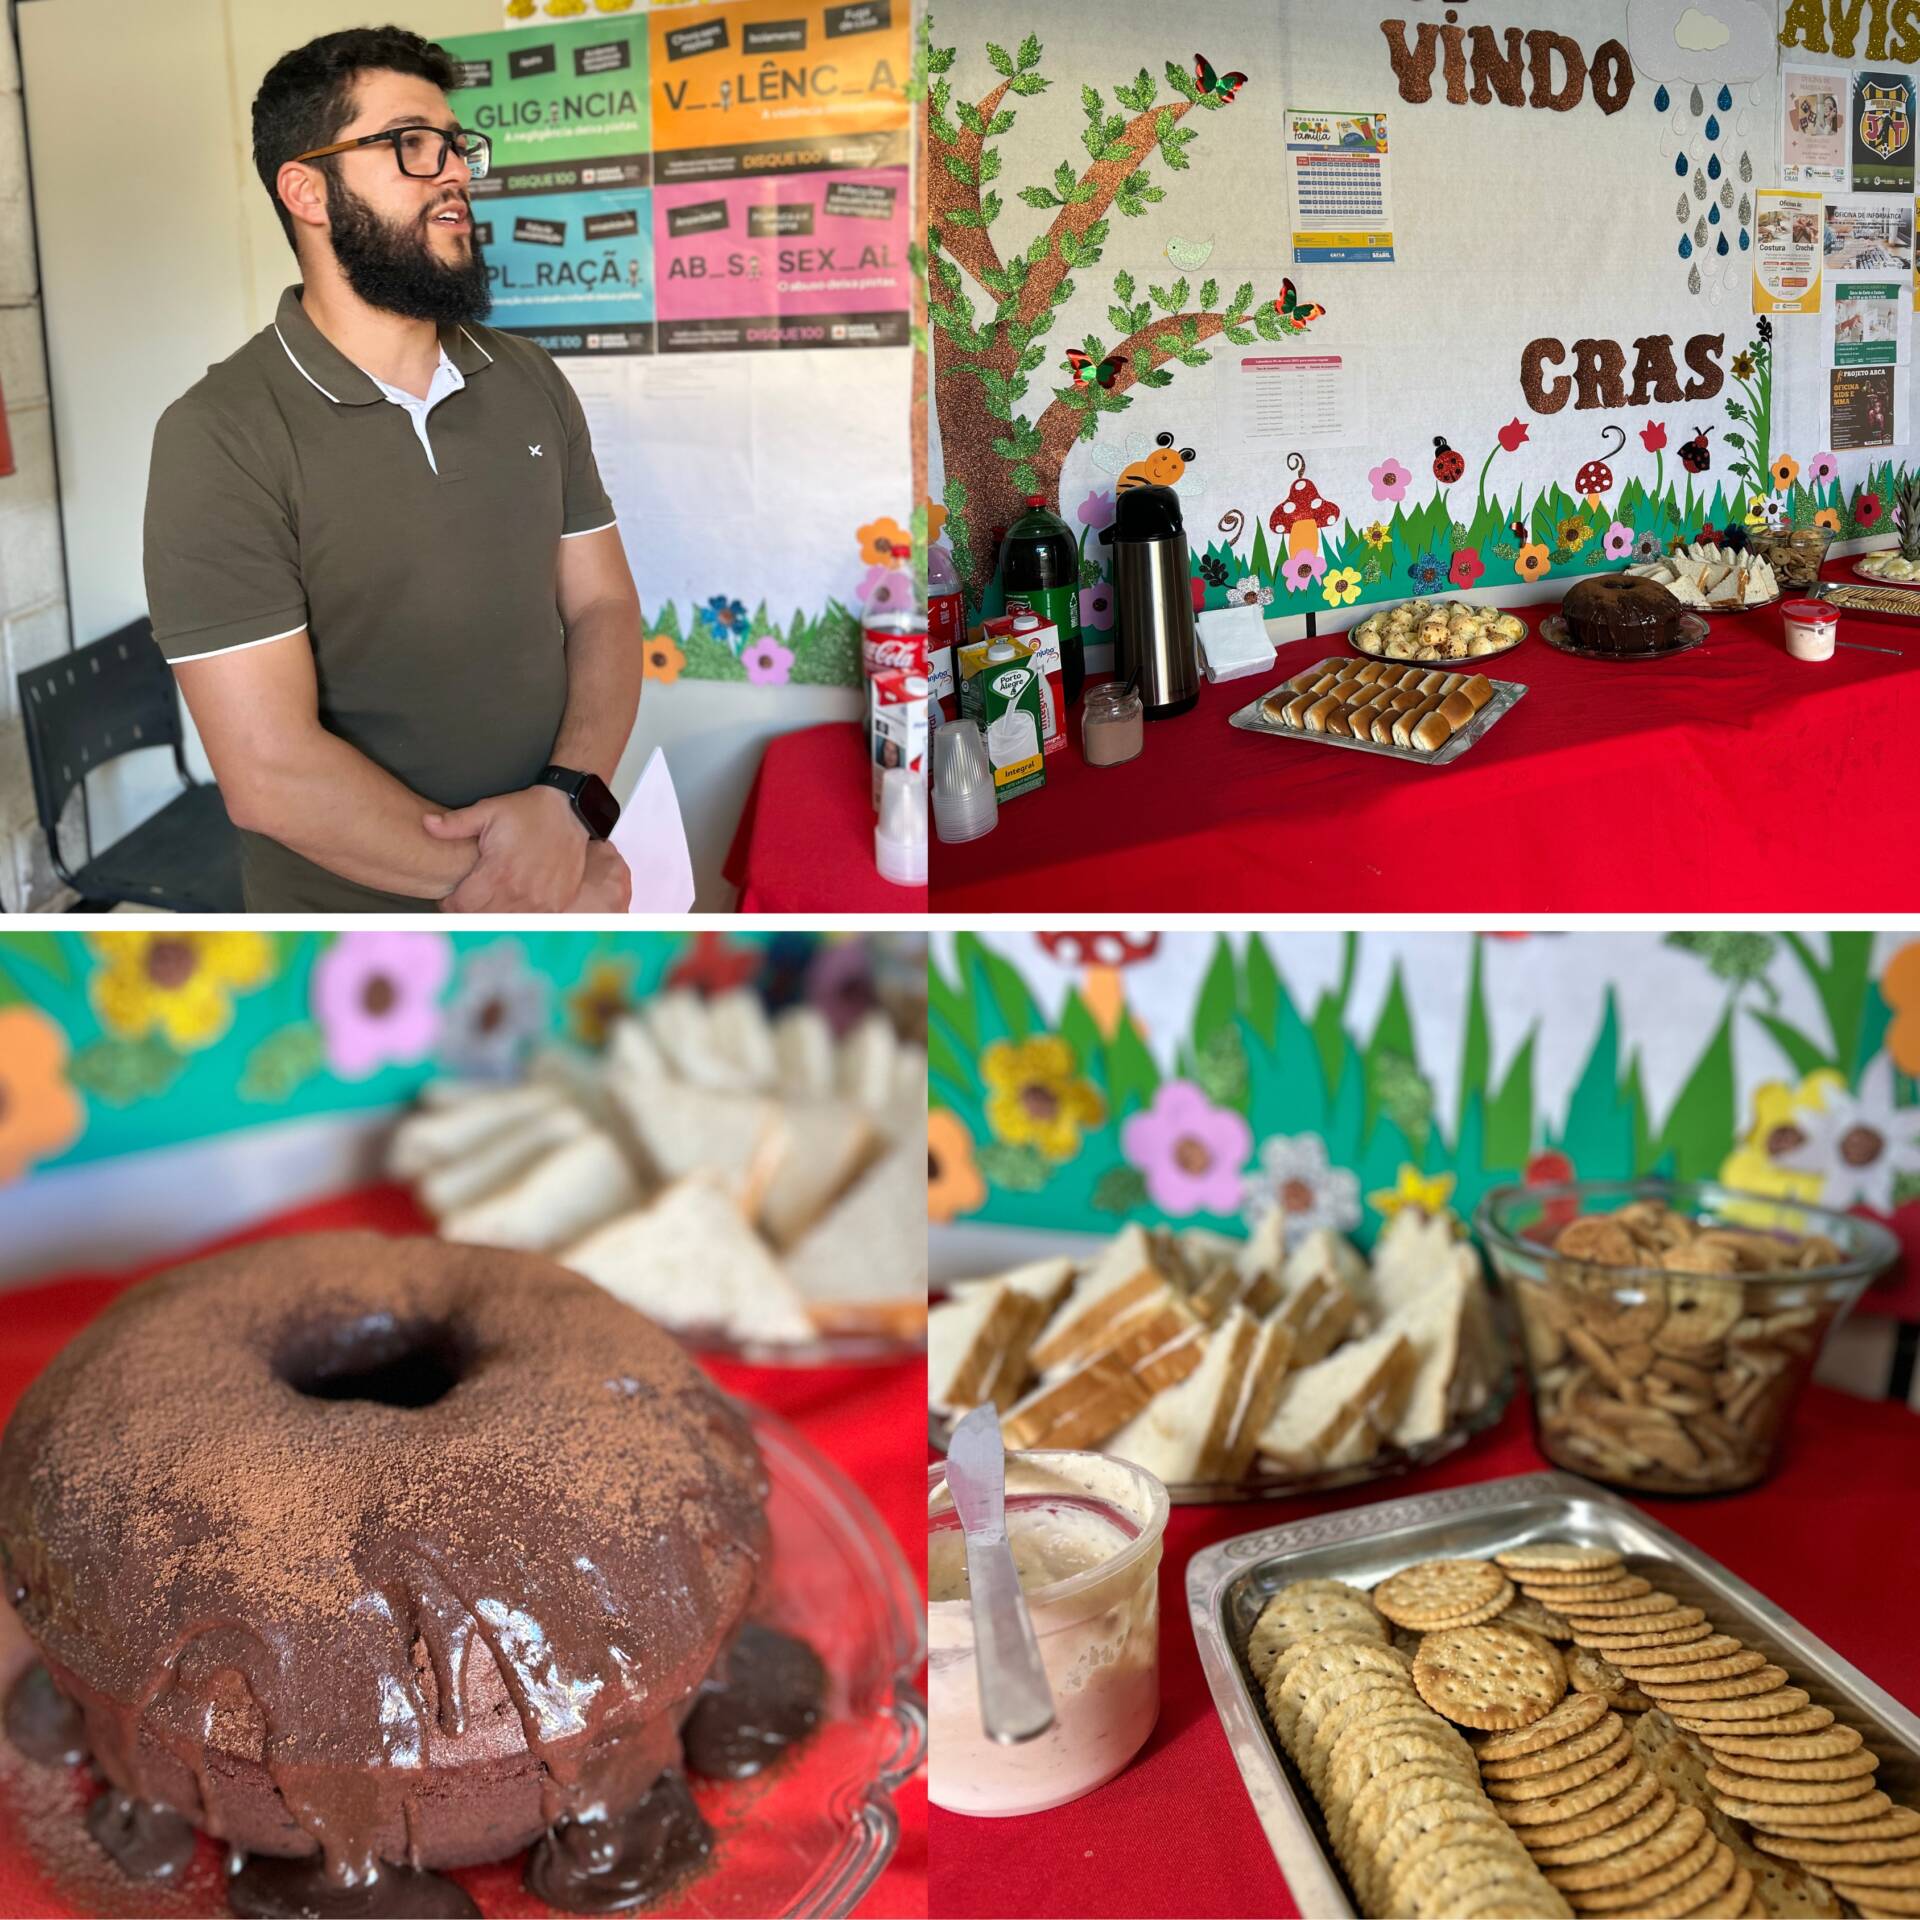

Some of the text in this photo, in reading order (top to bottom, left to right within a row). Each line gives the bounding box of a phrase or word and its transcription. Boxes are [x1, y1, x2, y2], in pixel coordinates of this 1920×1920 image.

[1520, 333, 1725, 415] CRAS
[1000, 673, 1022, 683] Porto
[1000, 679, 1024, 691] Alegre
[1005, 760, 1035, 777] Integral
